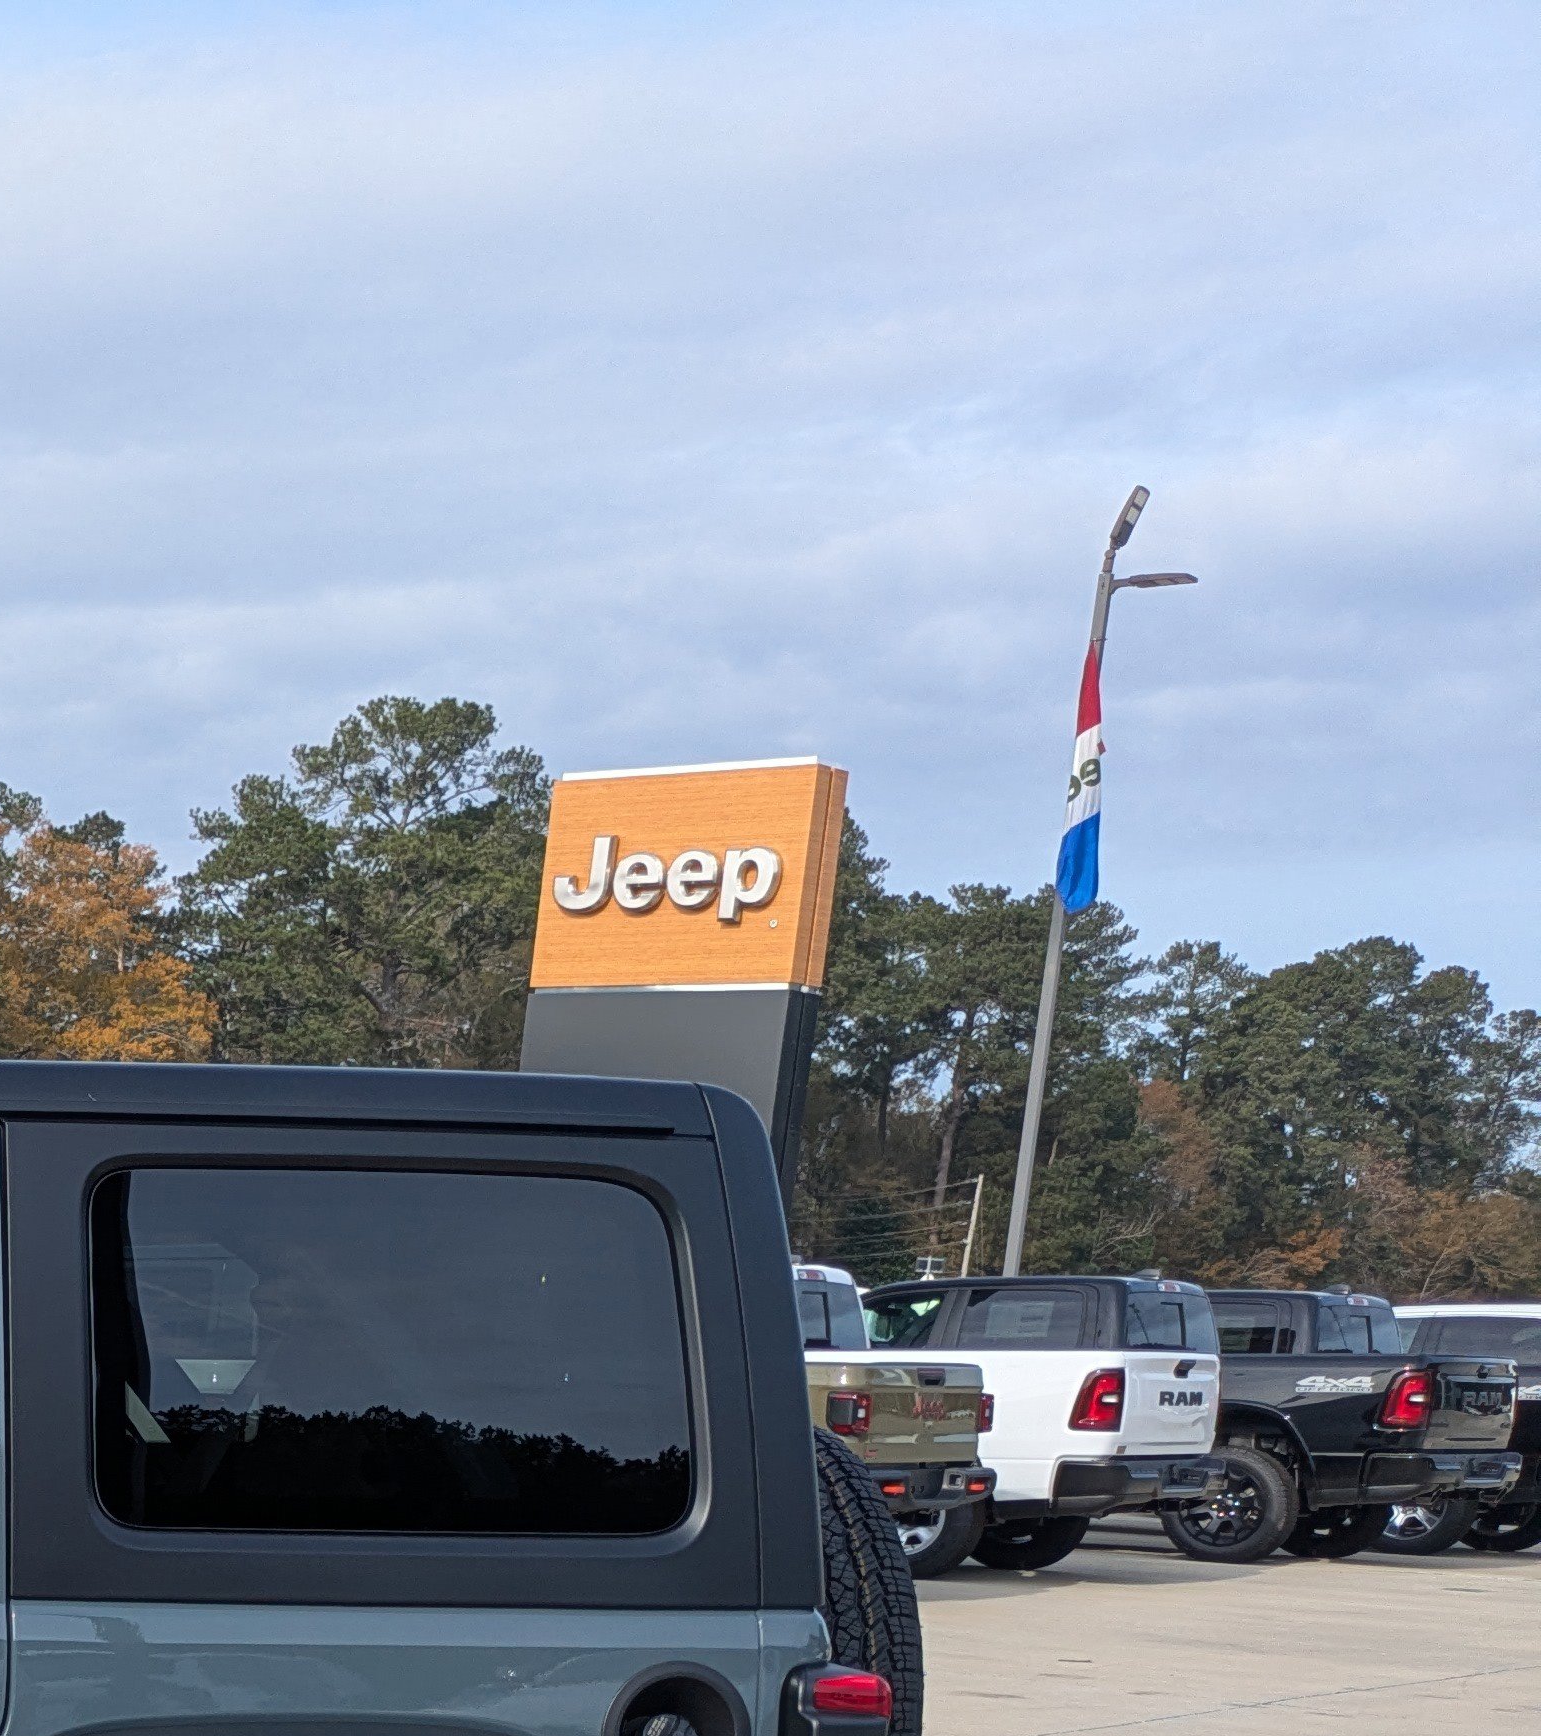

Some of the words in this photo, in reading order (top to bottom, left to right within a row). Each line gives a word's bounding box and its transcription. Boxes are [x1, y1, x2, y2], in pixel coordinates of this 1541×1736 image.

[553, 835, 782, 923] Jeep
[1159, 1391, 1203, 1406] RAM
[1462, 1391, 1502, 1406] RAM
